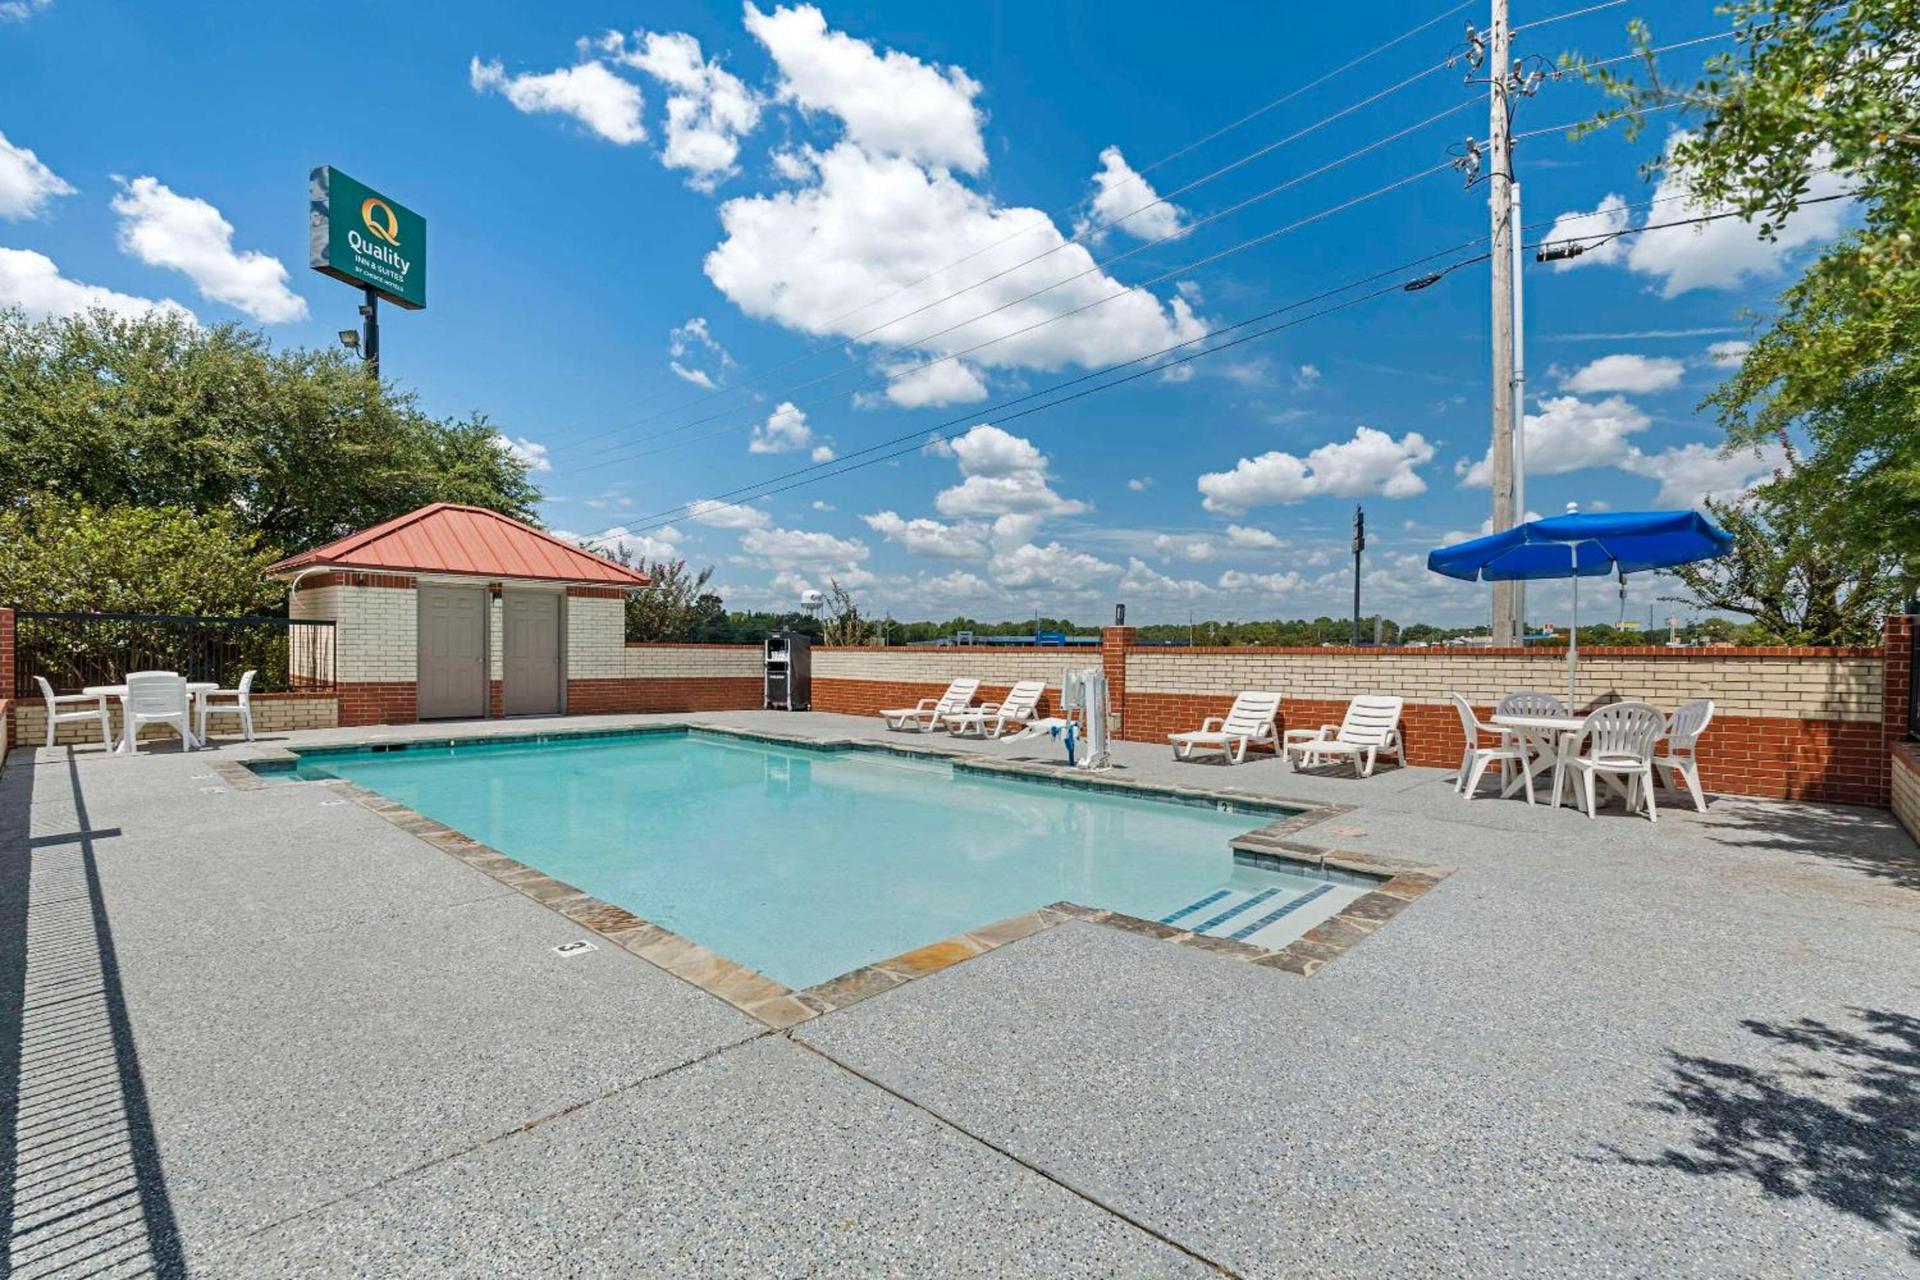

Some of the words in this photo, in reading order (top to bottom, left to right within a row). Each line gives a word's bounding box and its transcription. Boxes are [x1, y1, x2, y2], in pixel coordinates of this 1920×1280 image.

[362, 198, 401, 246] Q
[348, 230, 411, 275] Quality
[355, 254, 370, 267] INN
[370, 261, 377, 271] &
[377, 265, 404, 282] SUITES
[557, 942, 587, 951] 3
